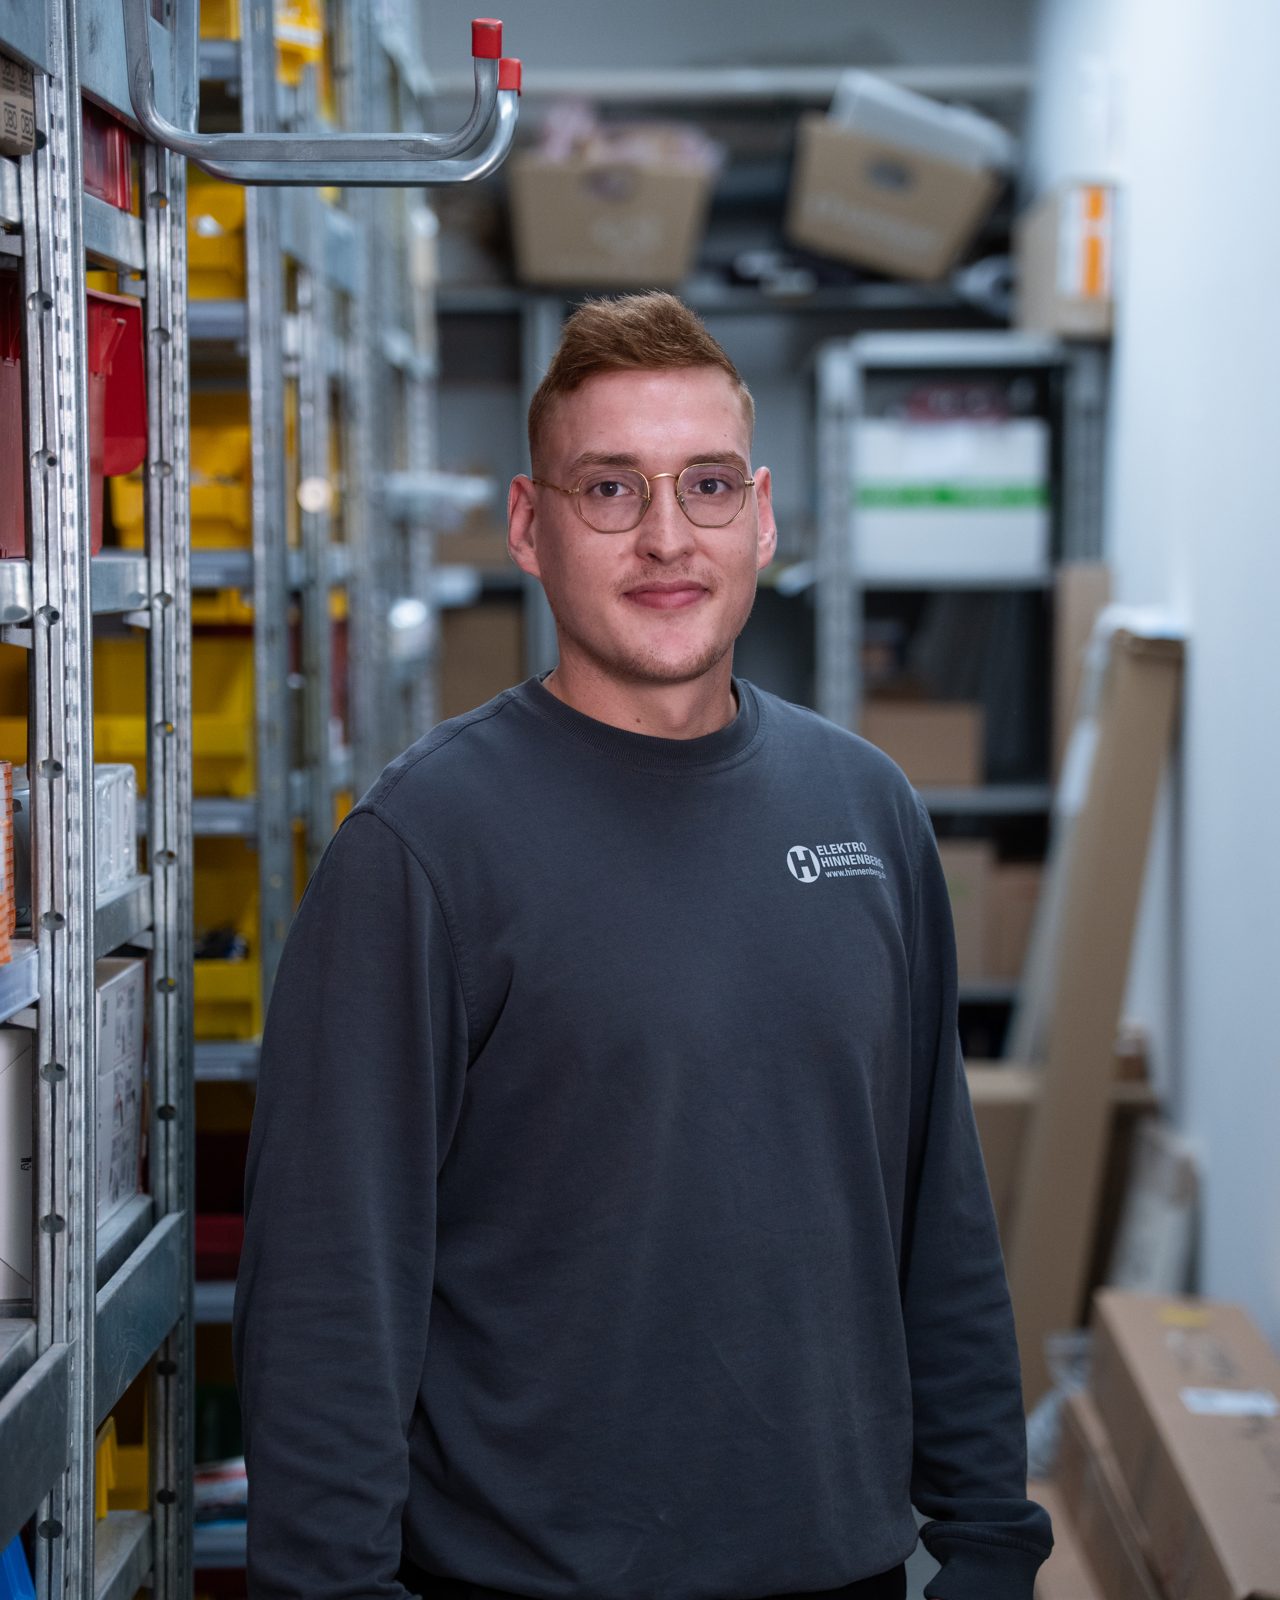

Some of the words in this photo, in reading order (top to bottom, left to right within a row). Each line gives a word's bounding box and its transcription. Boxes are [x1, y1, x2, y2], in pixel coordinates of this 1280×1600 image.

[4, 107, 17, 130] OBO
[816, 842, 867, 856] ELEKTRO
[788, 848, 819, 881] H
[820, 854, 884, 869] HINNENBERG
